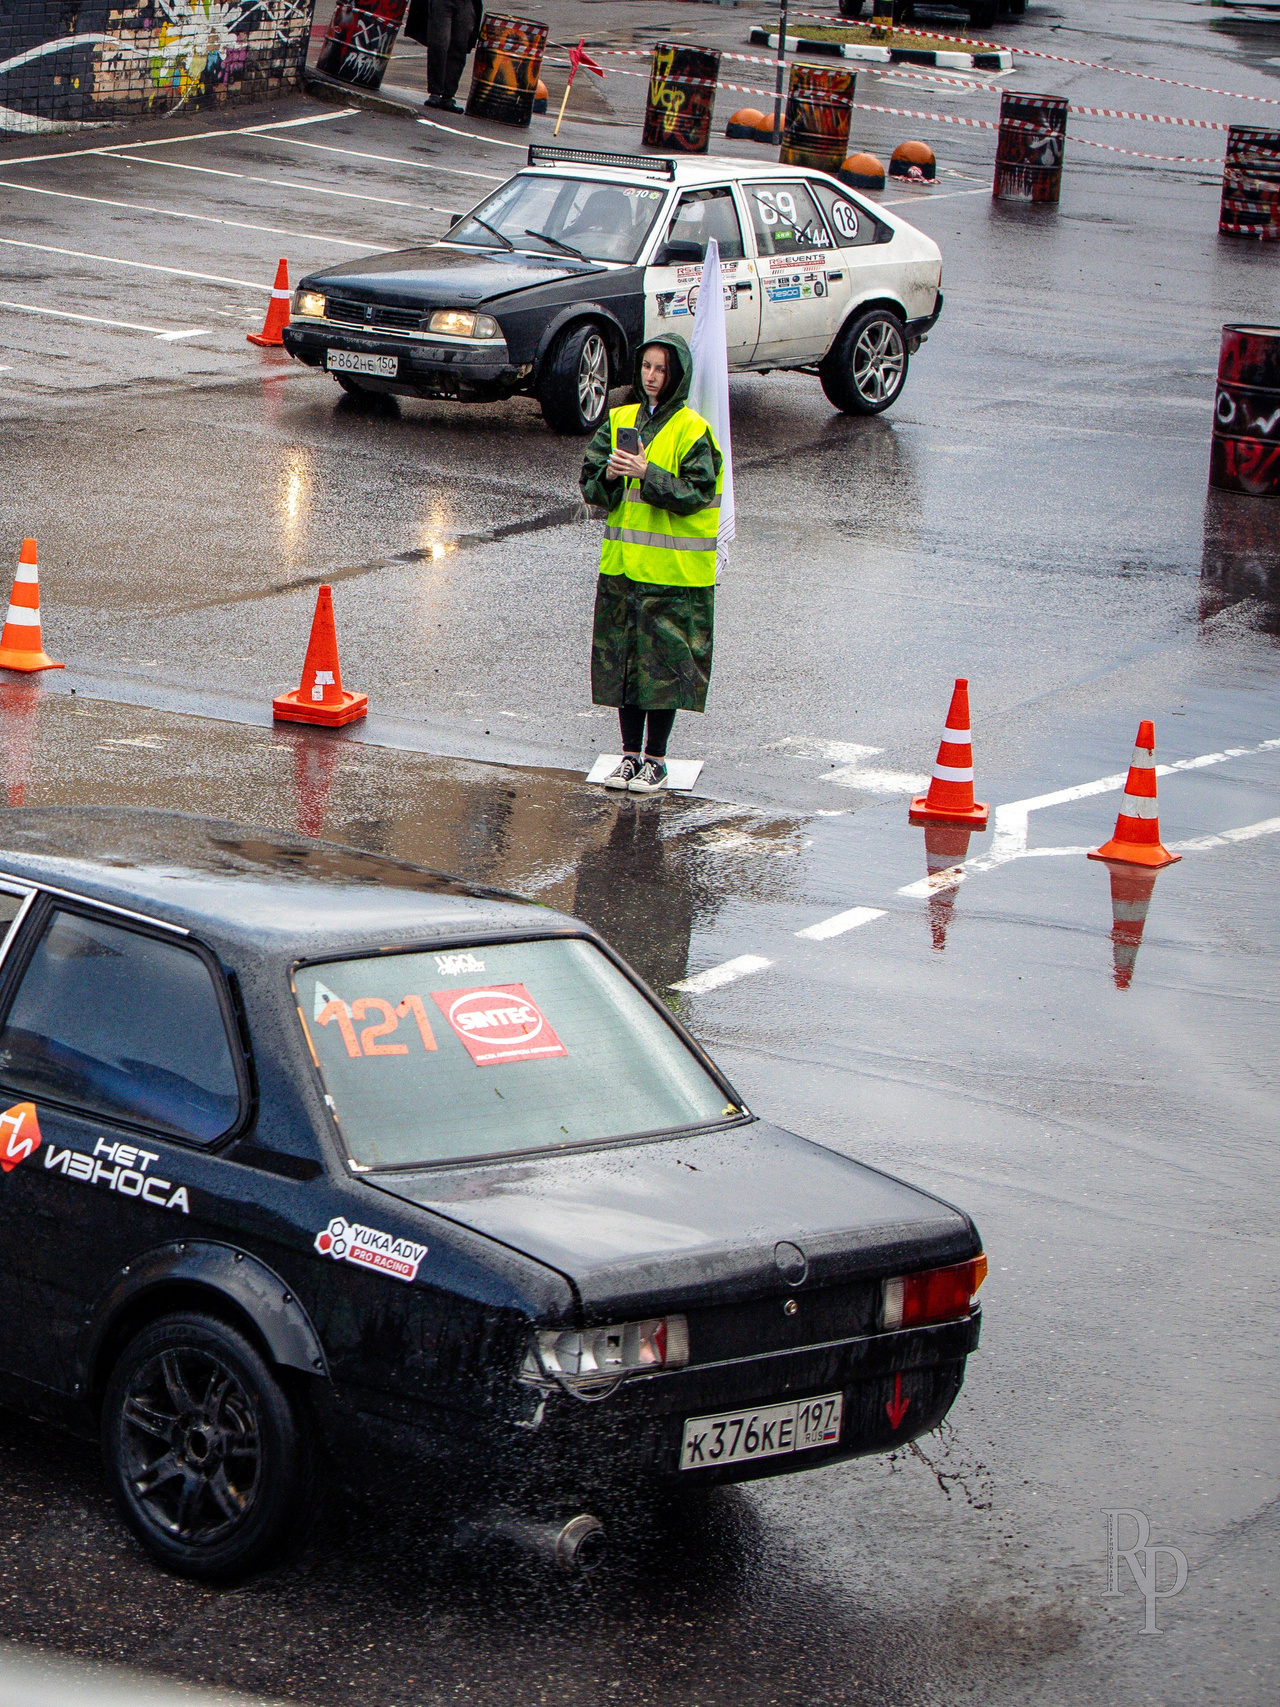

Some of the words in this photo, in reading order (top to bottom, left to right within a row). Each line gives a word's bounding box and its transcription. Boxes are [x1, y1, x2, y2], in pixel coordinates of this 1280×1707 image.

[635, 189, 649, 198] 10
[757, 191, 797, 225] 69
[835, 206, 856, 232] 18
[785, 253, 826, 264] EVENTS
[377, 356, 394, 370] 150
[315, 994, 438, 1058] 121
[455, 1006, 537, 1031] SINTEC
[92, 1137, 160, 1172] НЕТ
[43, 1144, 190, 1215] ИЗНОСА
[354, 1227, 390, 1252] YUKA
[391, 1242, 424, 1262] ADV
[353, 1248, 373, 1262] PRO
[373, 1255, 410, 1274] RACING
[690, 1415, 794, 1463] К376КЕ
[799, 1400, 836, 1433] 197
[804, 1430, 824, 1444] RUS
